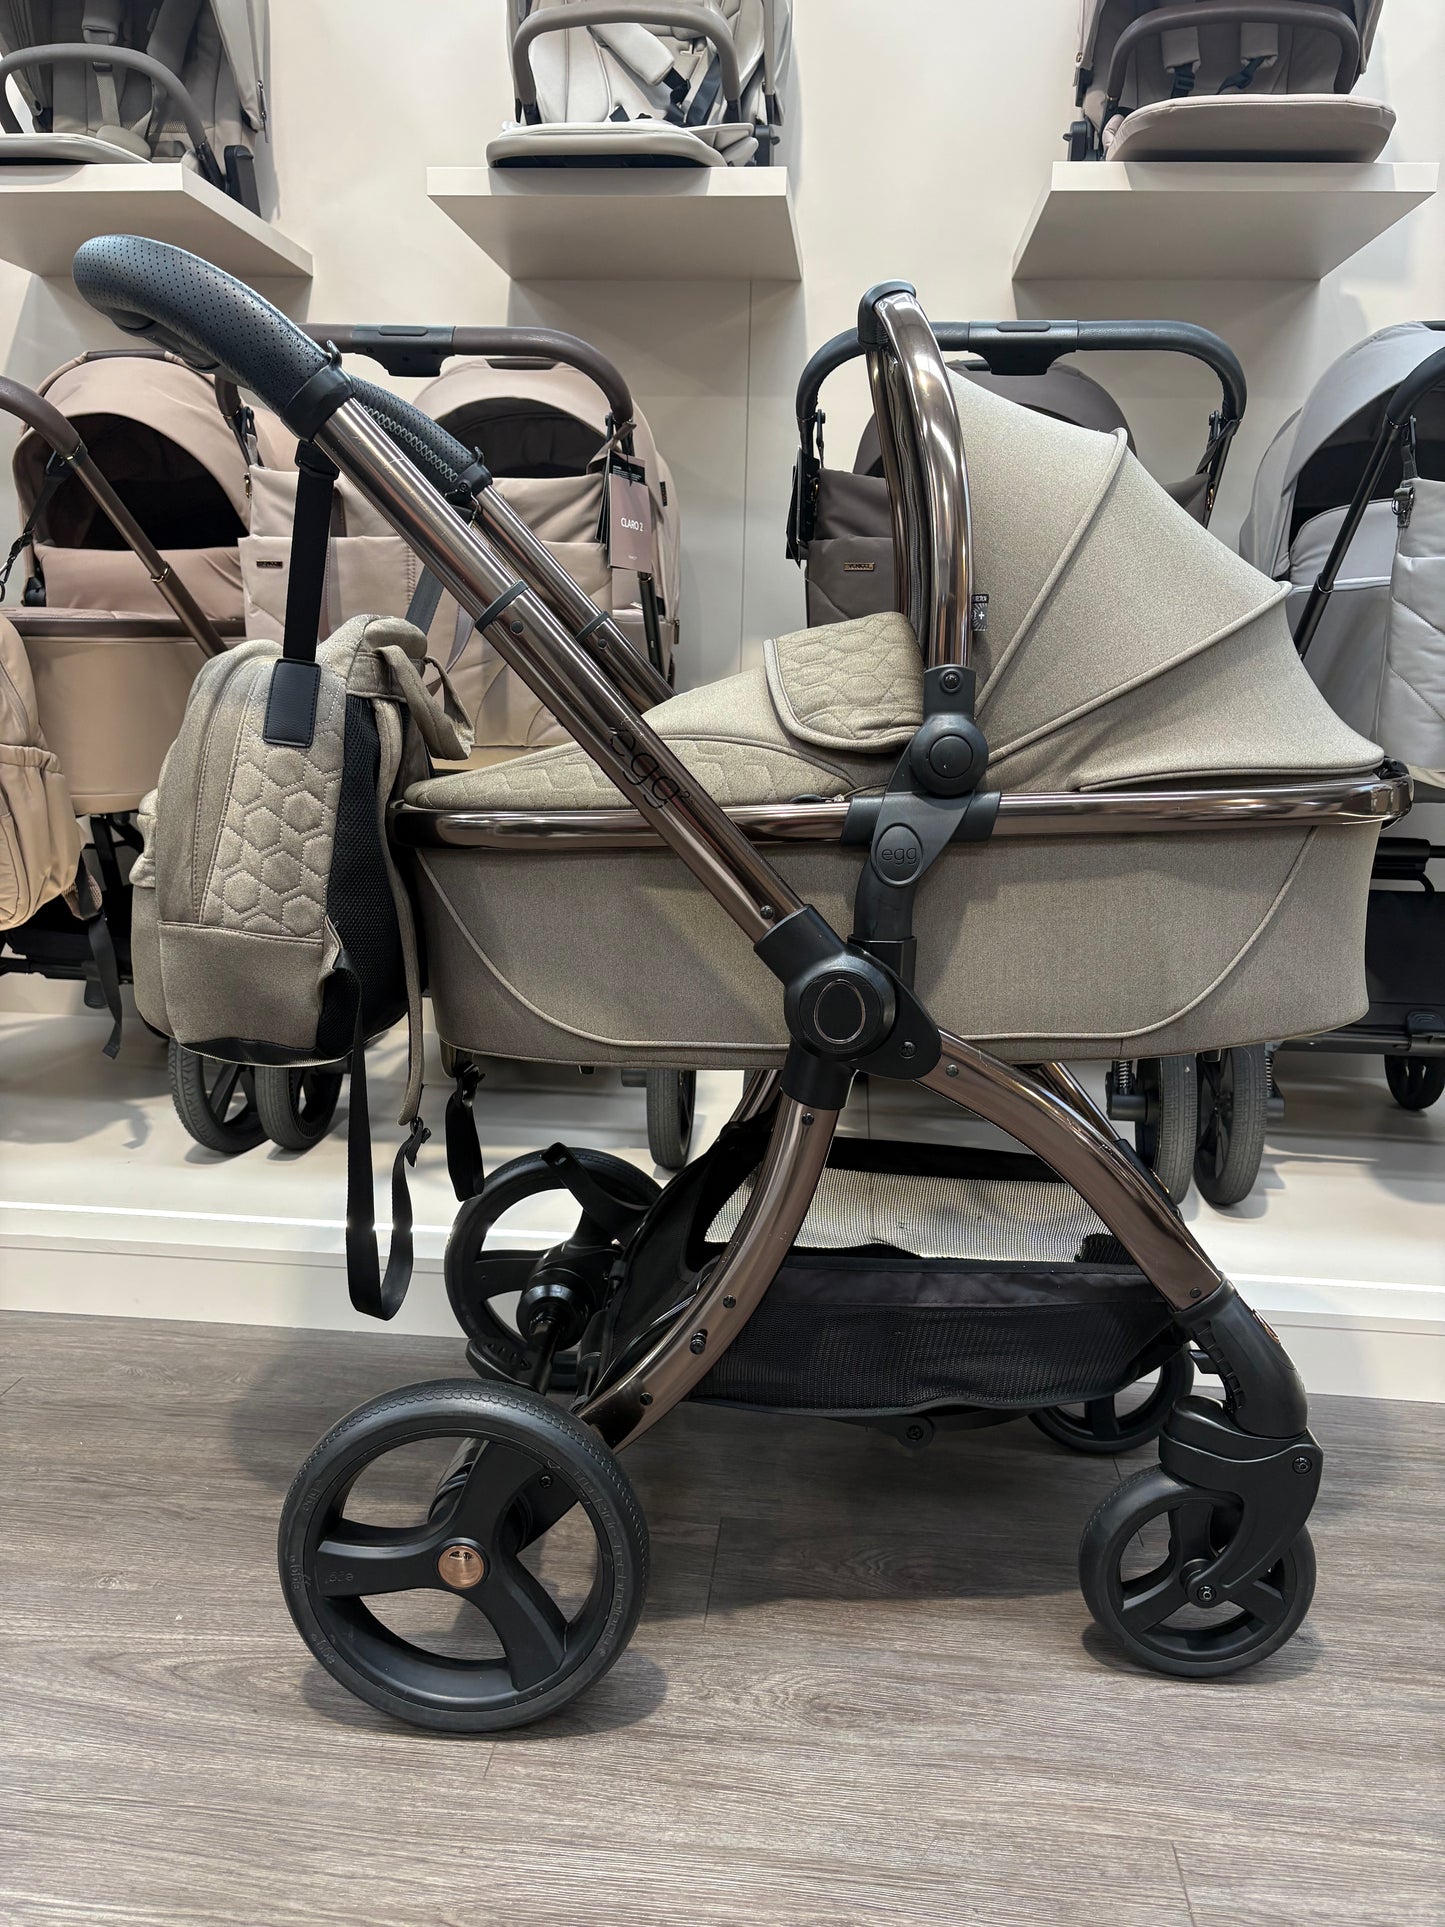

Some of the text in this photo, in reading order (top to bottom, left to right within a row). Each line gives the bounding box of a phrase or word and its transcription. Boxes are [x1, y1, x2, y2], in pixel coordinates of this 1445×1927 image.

[620, 517, 644, 532] CLARO 2
[881, 847, 917, 866] egg
